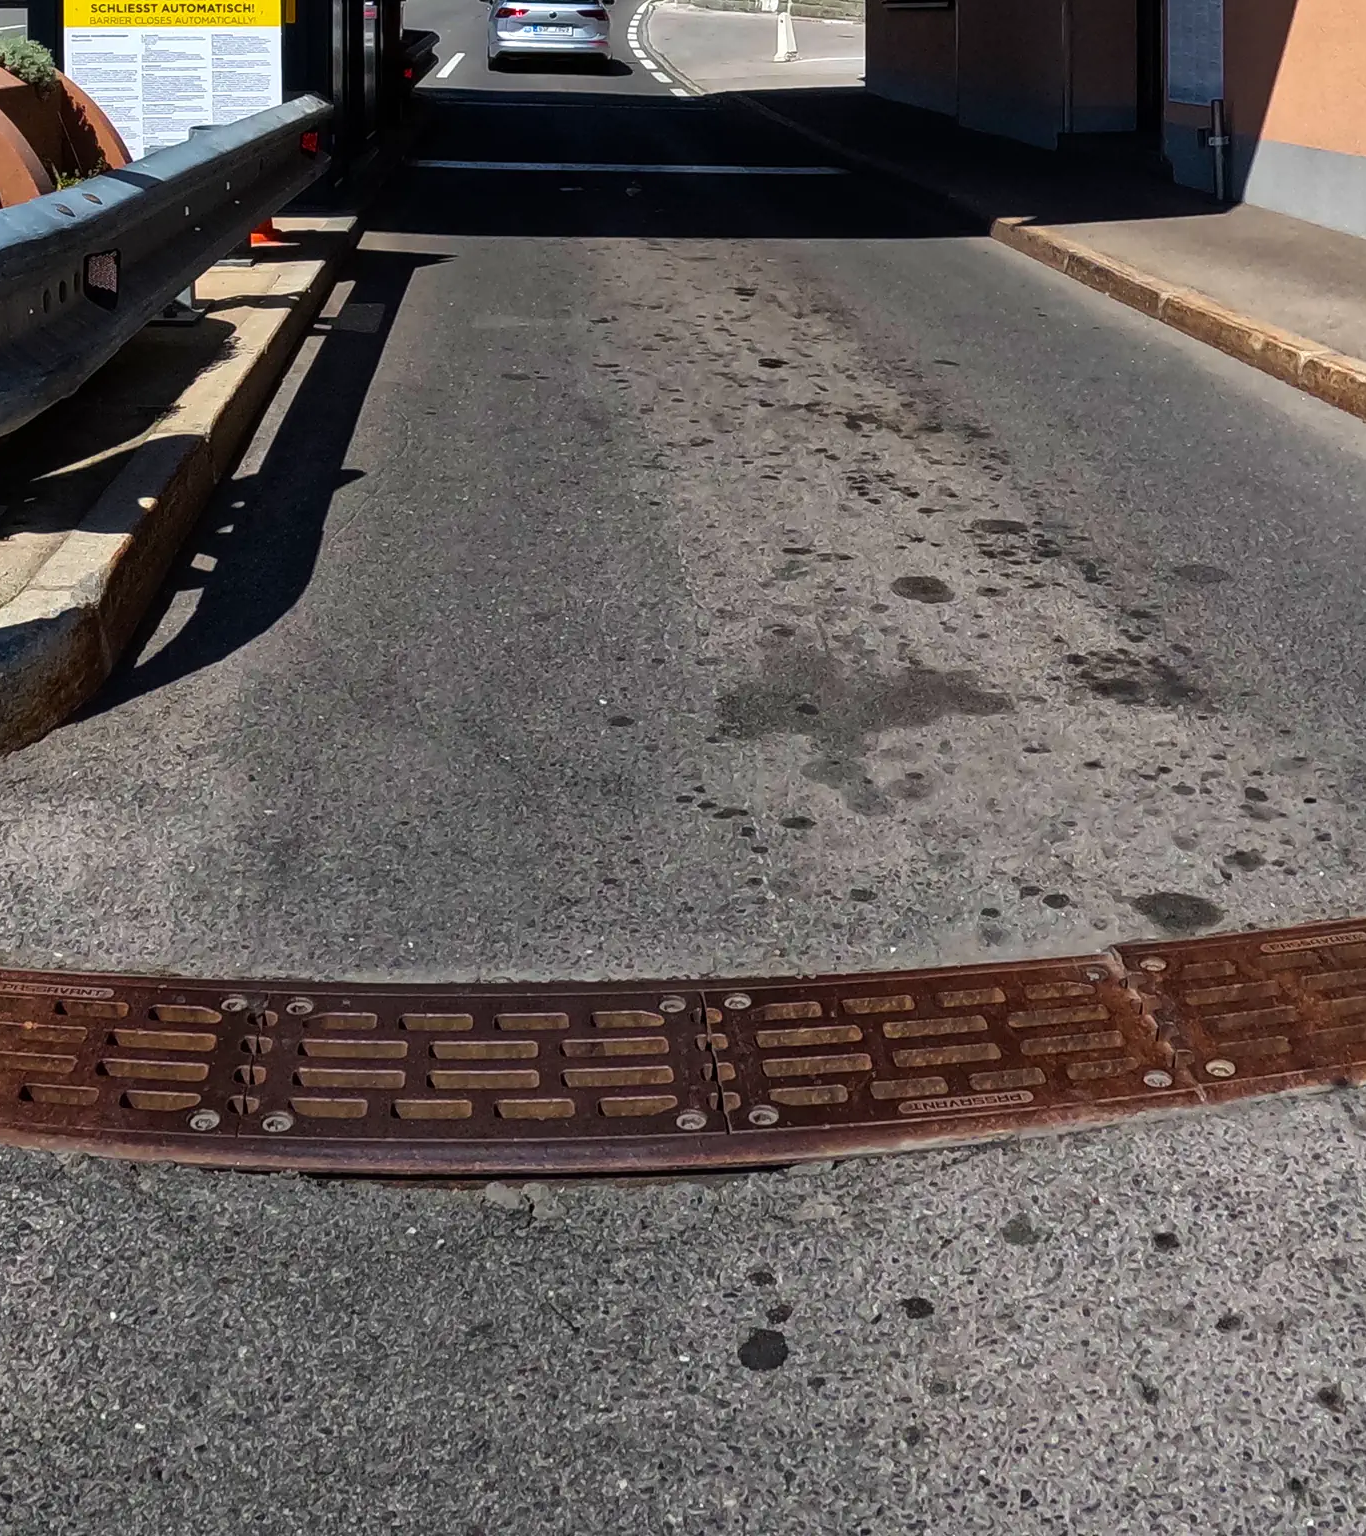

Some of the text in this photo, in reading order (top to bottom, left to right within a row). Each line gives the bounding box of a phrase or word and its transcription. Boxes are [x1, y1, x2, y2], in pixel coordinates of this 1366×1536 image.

[90, 4, 255, 14] SCHLIESST AUTOMATISCH!
[90, 17, 132, 25] BARRIER
[135, 17, 172, 25] CLOSES
[911, 1092, 1022, 1111] PASSAVANT
